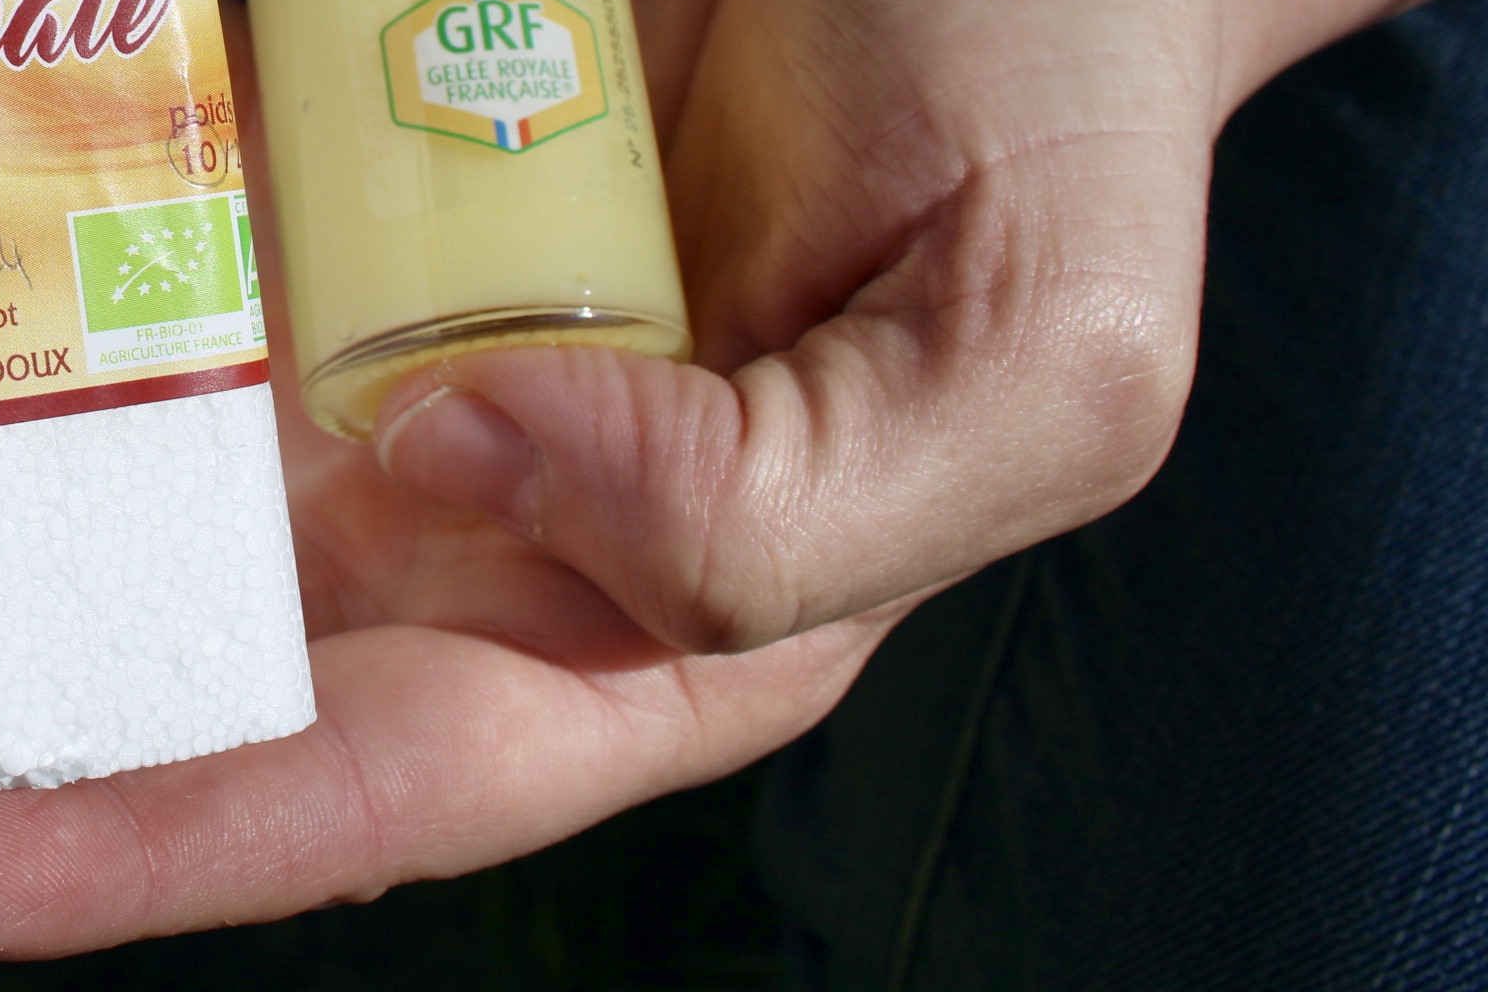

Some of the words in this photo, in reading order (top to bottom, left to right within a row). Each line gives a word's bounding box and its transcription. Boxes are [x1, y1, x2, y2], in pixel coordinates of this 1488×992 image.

[427, 57, 490, 86] GELÉE
[497, 58, 573, 81] ROYALE
[169, 92, 234, 139] poids
[136, 321, 204, 342] FR-BIO-01
[99, 339, 190, 366] AGRICULTURE
[194, 331, 243, 351] FRANCE
